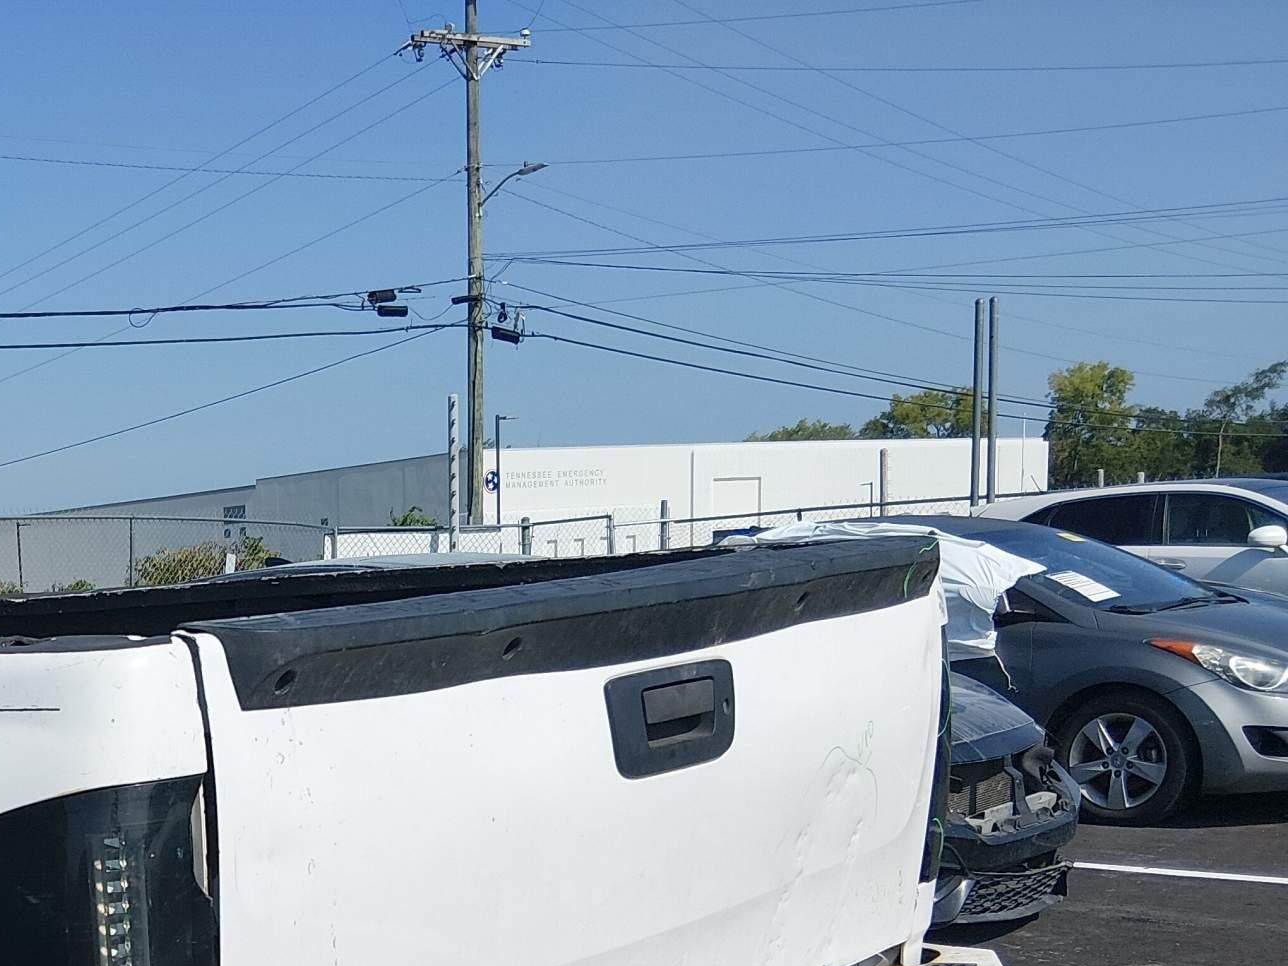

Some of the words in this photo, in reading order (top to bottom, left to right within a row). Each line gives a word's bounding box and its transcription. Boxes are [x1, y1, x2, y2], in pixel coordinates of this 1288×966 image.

[505, 470, 552, 480] TENNESSEE
[556, 469, 604, 479] EMERGENCY
[505, 479, 559, 489] MANAGEMENT
[564, 478, 607, 487] AUTHORITY
